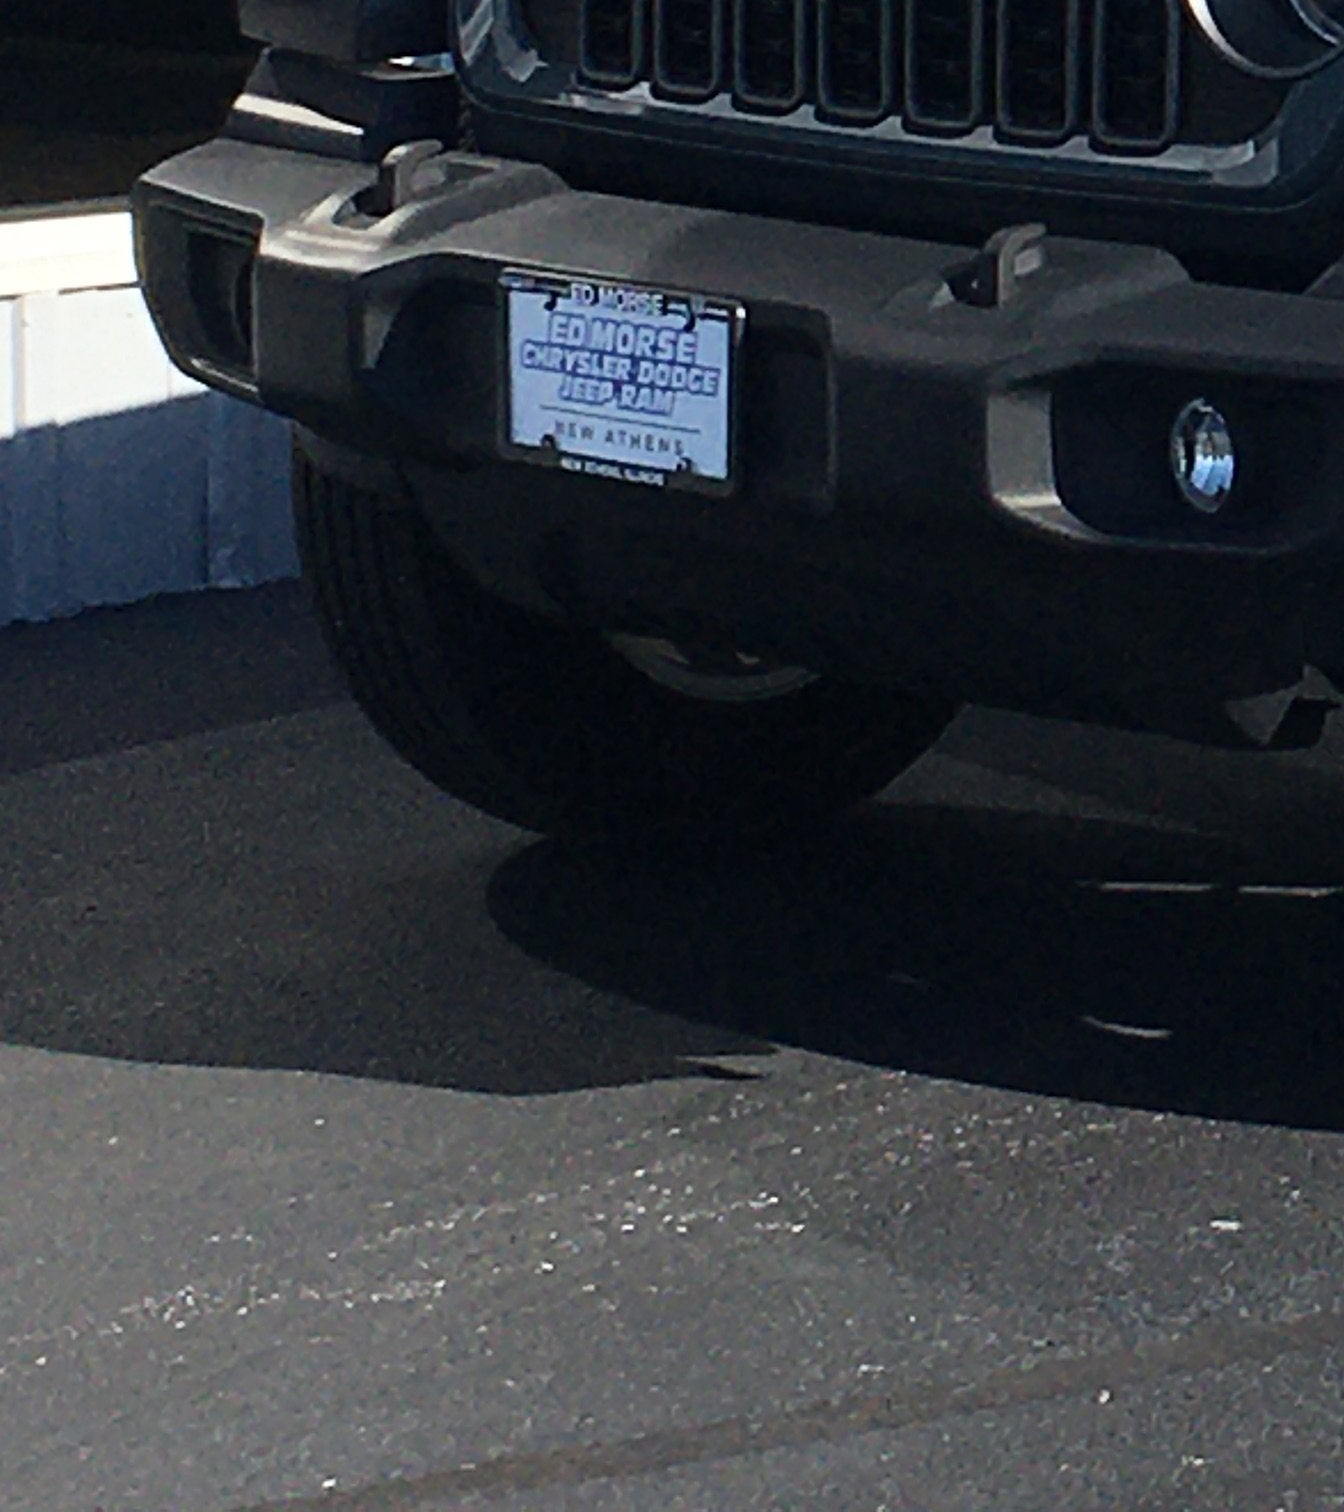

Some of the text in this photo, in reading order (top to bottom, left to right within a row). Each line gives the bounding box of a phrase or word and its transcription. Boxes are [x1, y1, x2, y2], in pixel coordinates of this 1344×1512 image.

[571, 284, 664, 317] ED MORSE
[549, 311, 698, 364] ED MORSE
[521, 341, 720, 396] CHRYSLER DODGE
[559, 374, 675, 417] JEEP RAM
[554, 419, 685, 457] NEW ATHENS
